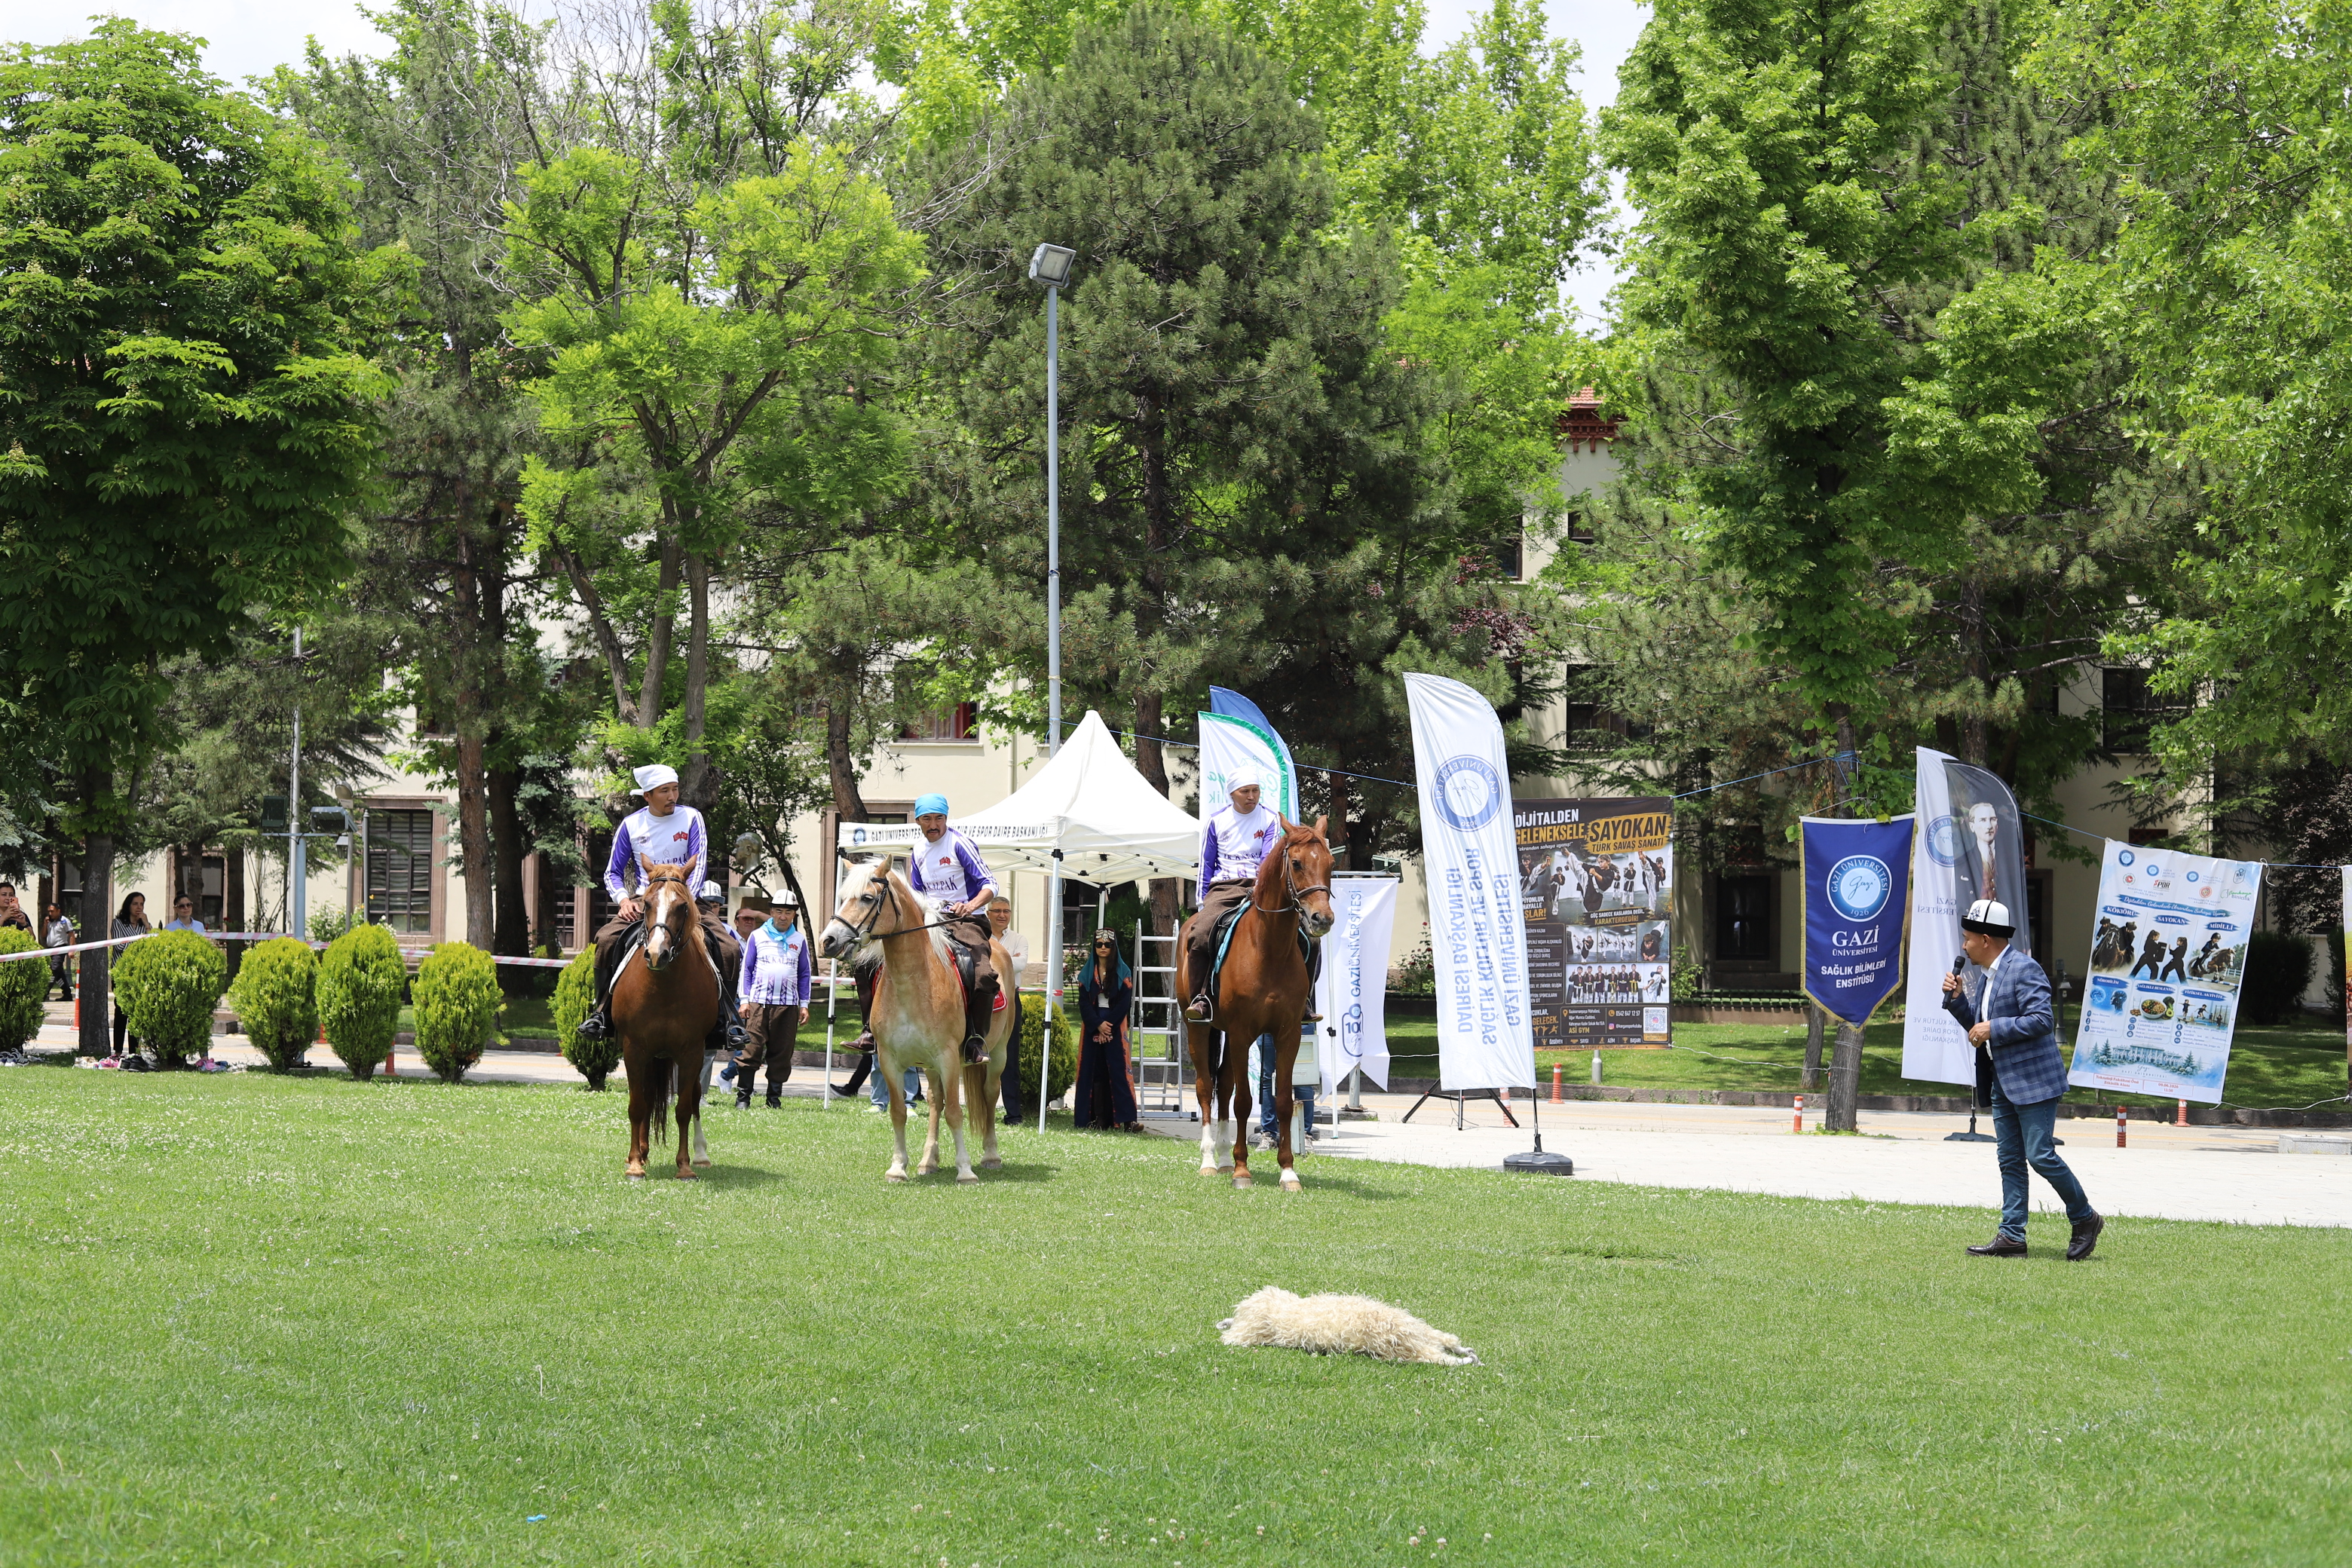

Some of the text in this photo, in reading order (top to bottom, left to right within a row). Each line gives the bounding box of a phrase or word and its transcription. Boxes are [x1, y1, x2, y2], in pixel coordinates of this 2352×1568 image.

[1515, 808, 1579, 828] DİJİTALDEN
[1589, 815, 1667, 843] SAYOKAN
[1592, 838, 1664, 853] TÜRK SAVAŞ SANATI
[1831, 859, 1888, 893] GAZİ ÜNİVERSİTESİ
[1522, 896, 1545, 904] PİYONLUK
[1524, 908, 1546, 920] ŞLAR!
[1851, 908, 1870, 917] 1926
[2158, 916, 2186, 924] SAYOKAN
[1832, 925, 1879, 947] GAZİ
[1832, 945, 1878, 957] ÜNİVERSİTESİ
[1821, 957, 1886, 975] SAĞLIK BİLİMLERİ
[1836, 973, 1875, 988] ENSTİTÜSÜ
[1569, 1026, 1577, 1034] ASİ
